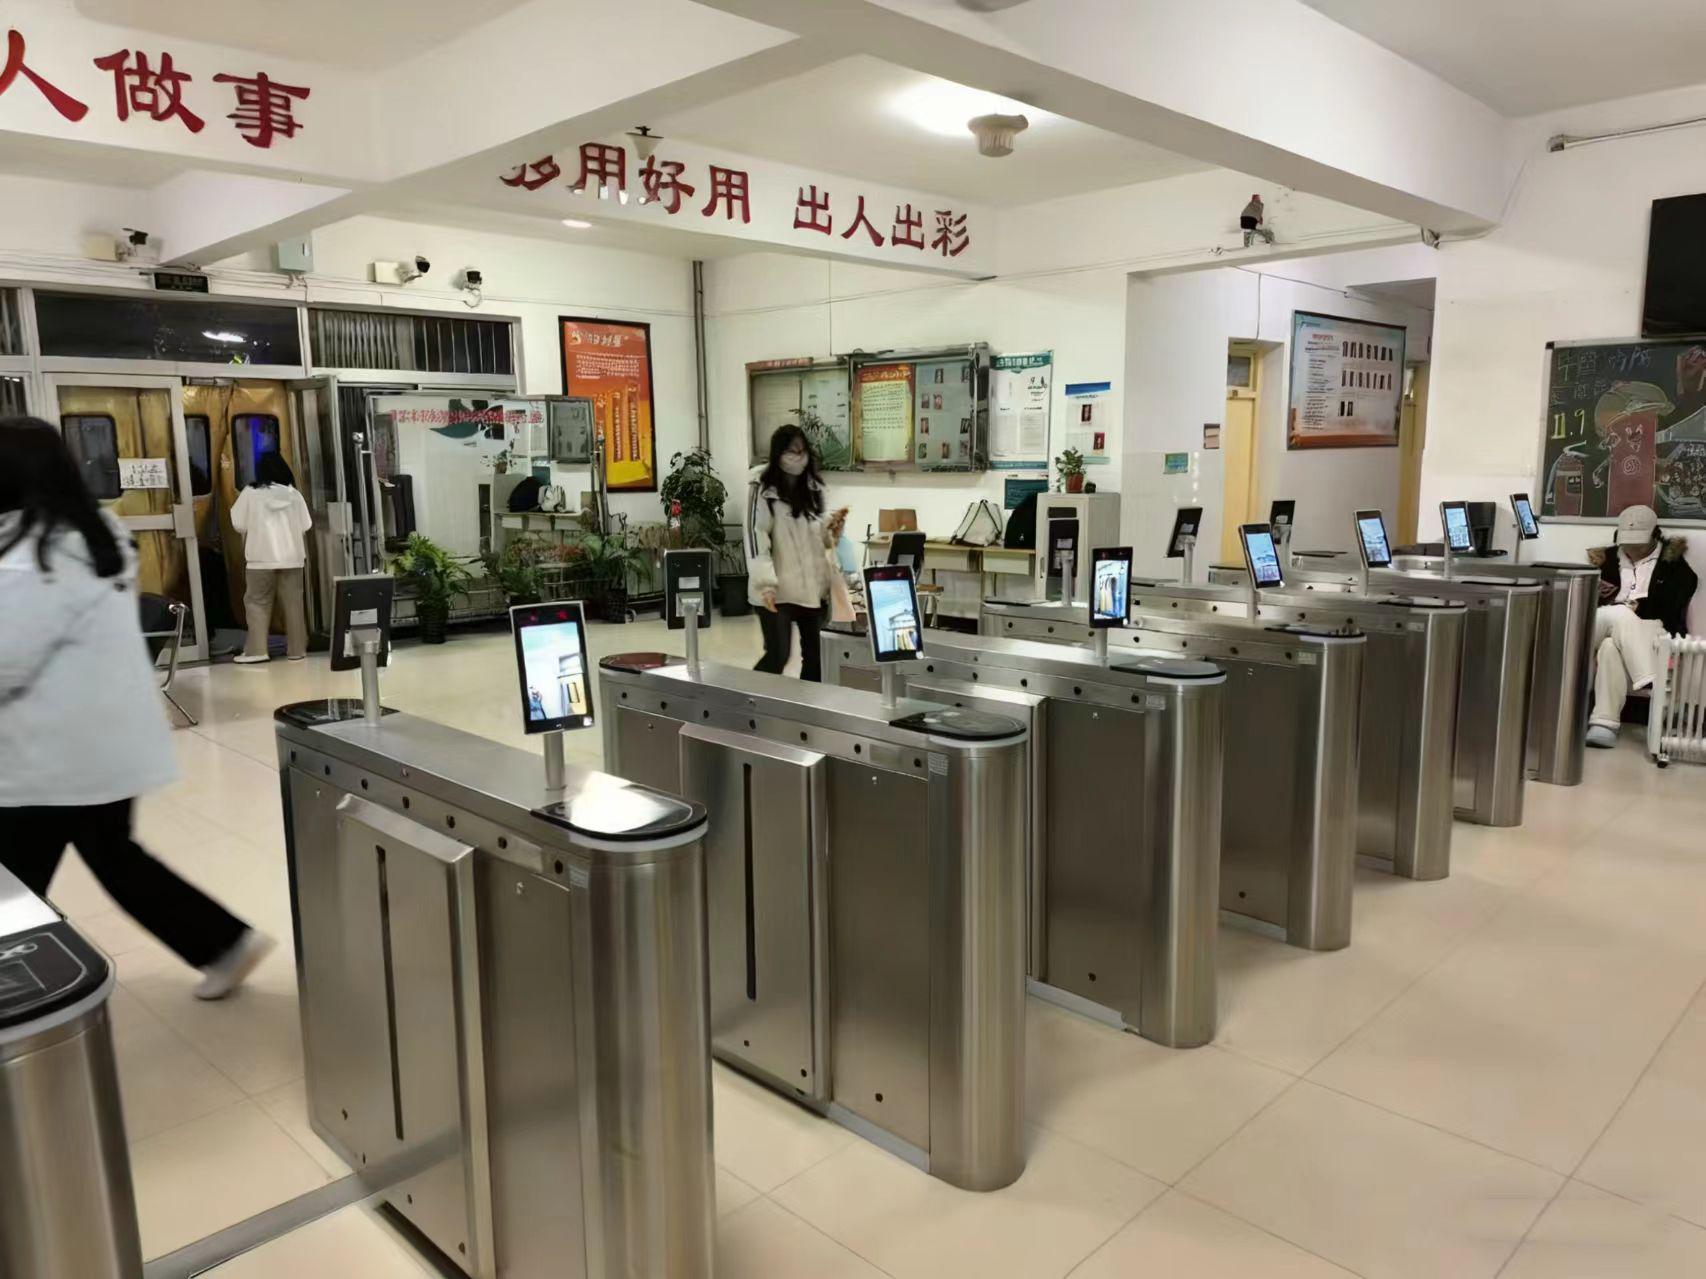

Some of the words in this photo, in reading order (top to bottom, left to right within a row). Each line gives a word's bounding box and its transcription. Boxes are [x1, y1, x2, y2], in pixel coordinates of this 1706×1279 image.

[0, 29, 312, 149] 人做事
[792, 184, 970, 257] 出人出彩
